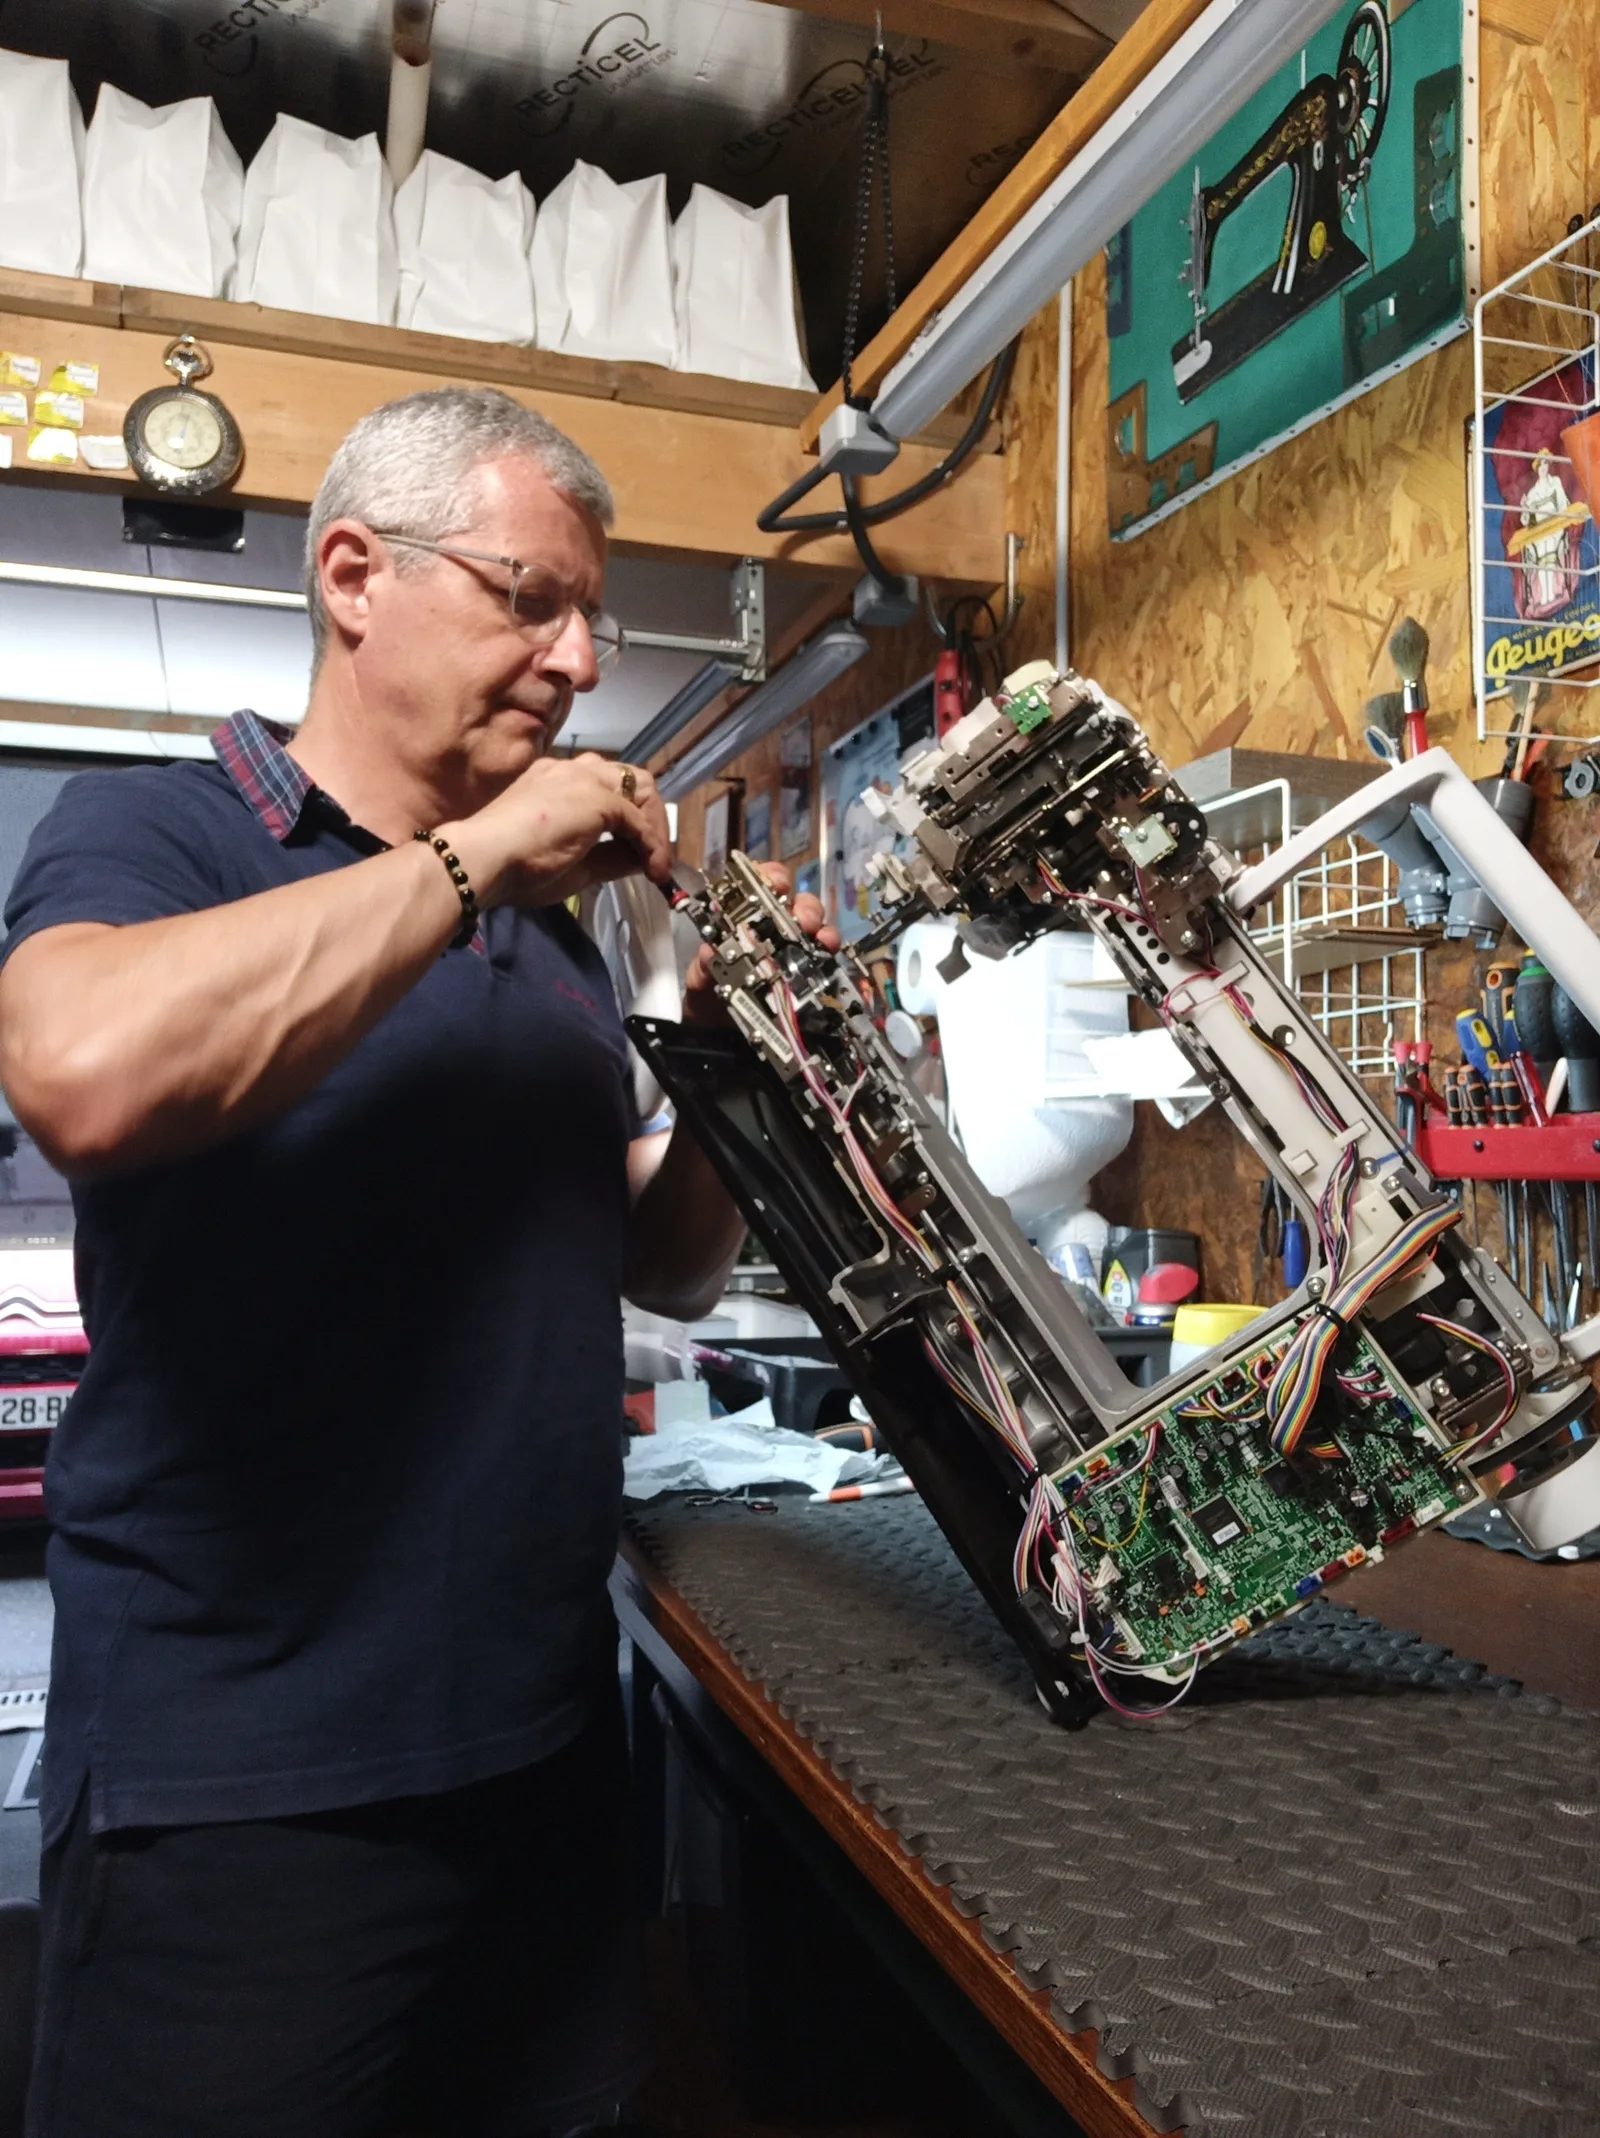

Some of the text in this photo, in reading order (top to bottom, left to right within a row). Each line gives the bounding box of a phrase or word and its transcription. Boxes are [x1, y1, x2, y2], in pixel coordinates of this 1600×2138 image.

[192, 0, 280, 53] RECTI
[513, 36, 662, 118] RECTICEL
[1485, 612, 1600, 690] Peugeo
[1, 1396, 73, 1425] 28-B
